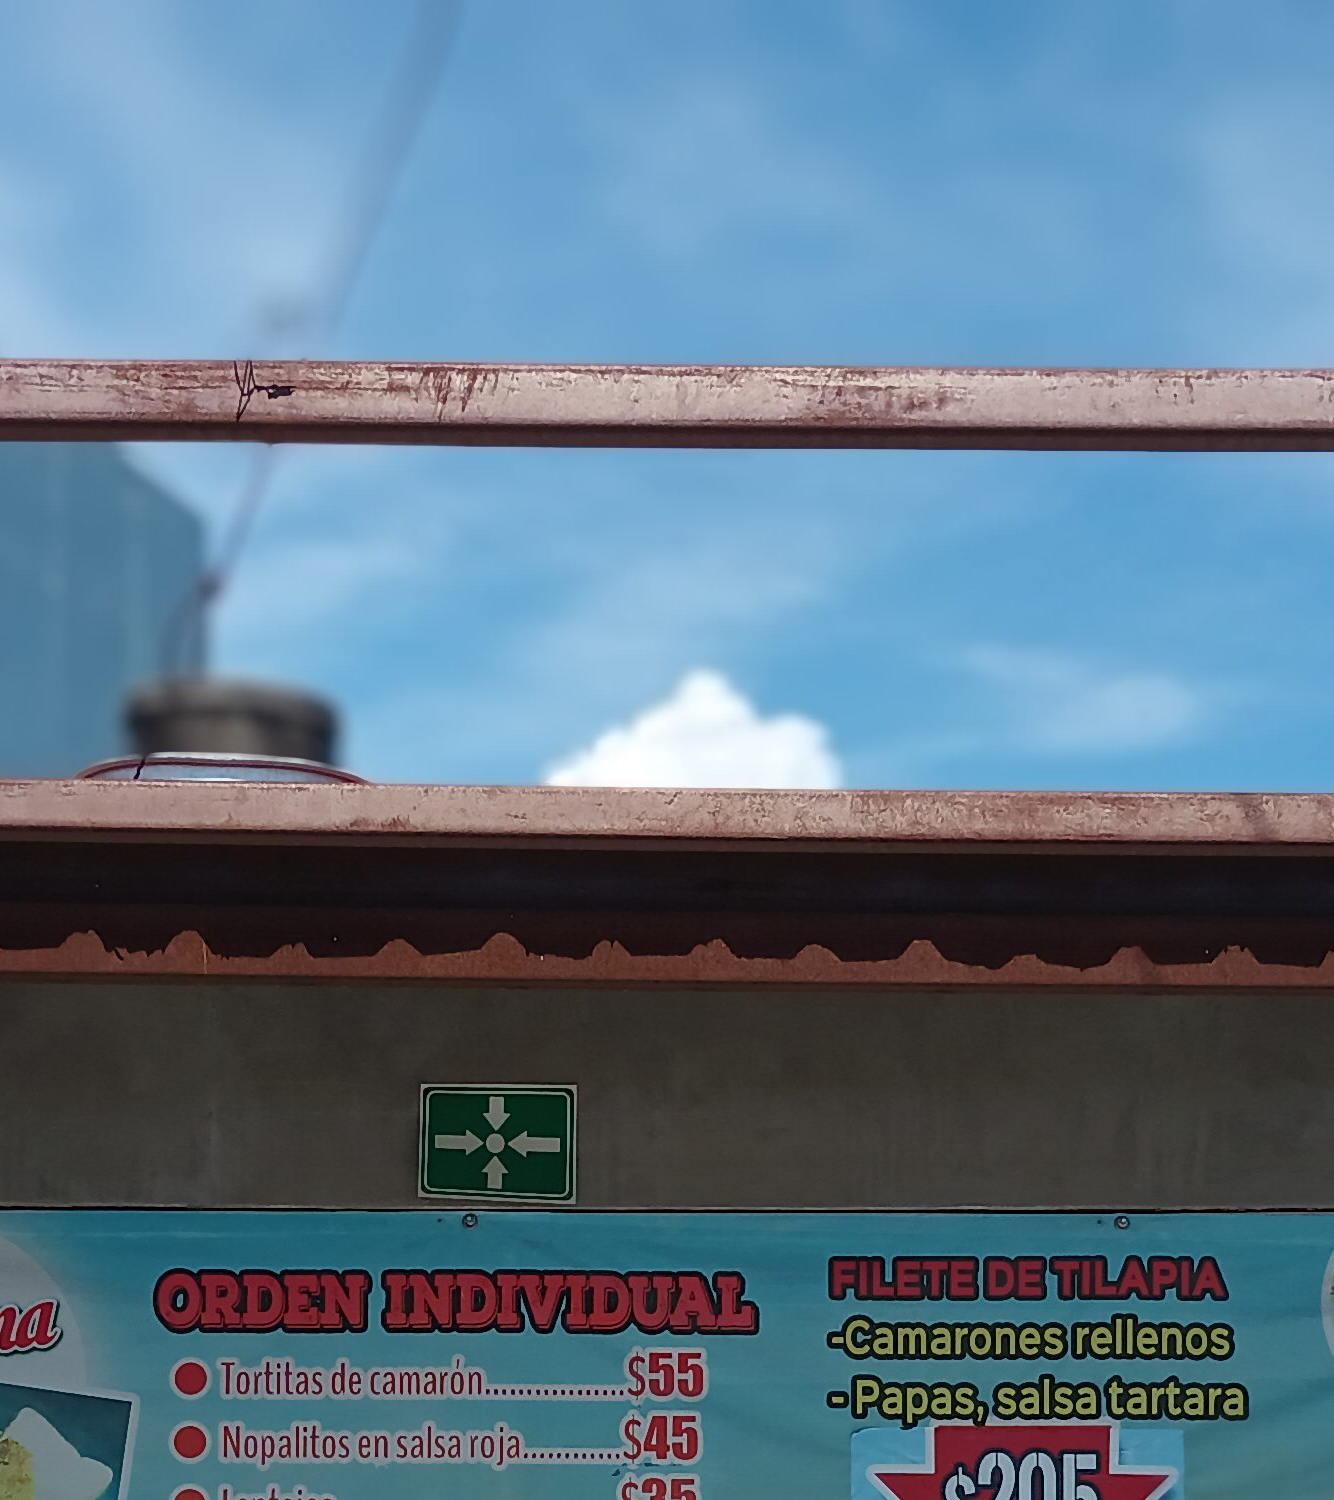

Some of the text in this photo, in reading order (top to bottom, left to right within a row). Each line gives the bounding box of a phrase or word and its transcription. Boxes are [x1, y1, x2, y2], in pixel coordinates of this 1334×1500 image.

[155, 1268, 759, 1335] ORDEN INDIVIDUAL
[828, 1257, 1229, 1300] FILETE DE TILAPIA
[1071, 1315, 1234, 1360] rellenos
[221, 1361, 323, 1396] Tortitas
[331, 1361, 362, 1396] de
[628, 1352, 702, 1399] $55
[994, 1377, 1102, 1419] salsa
[1105, 1378, 1248, 1419] tartara
[222, 1425, 350, 1466] Nopalitos
[358, 1433, 388, 1458] en
[396, 1425, 461, 1458] salsa
[623, 1414, 699, 1465] $45
